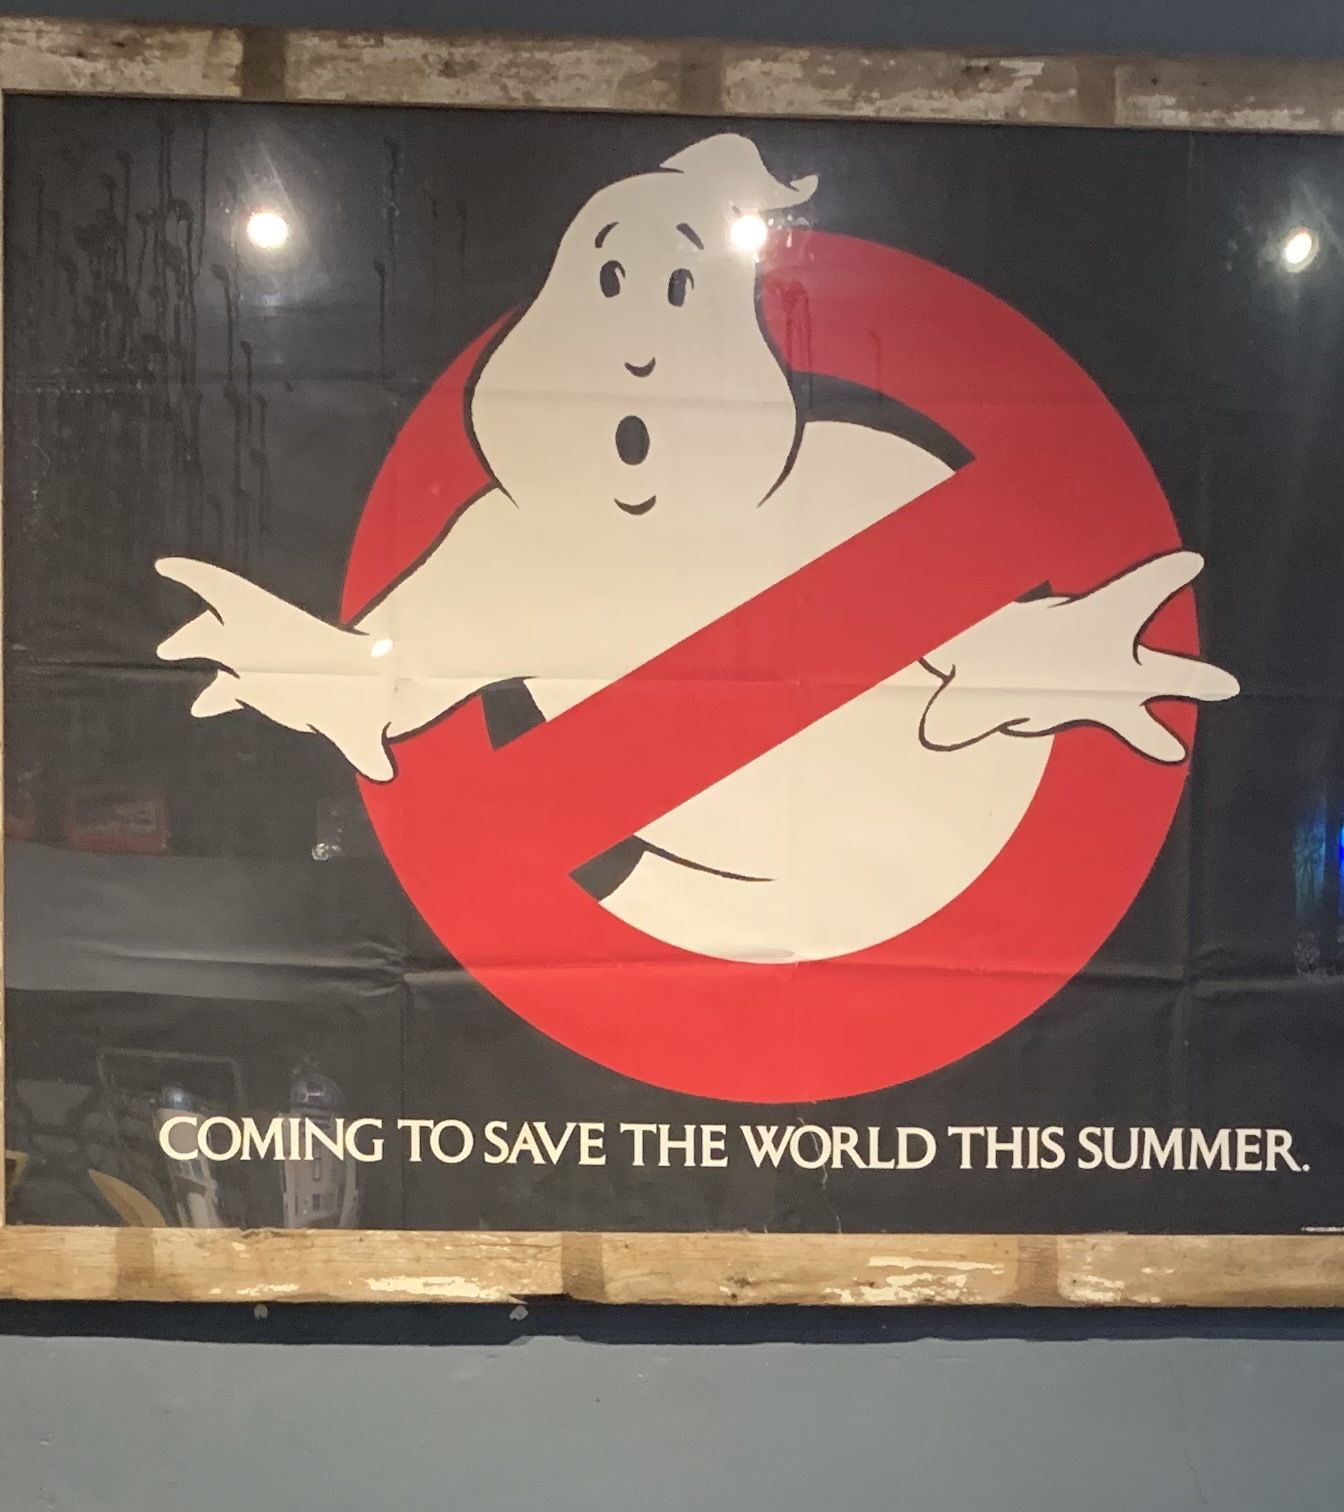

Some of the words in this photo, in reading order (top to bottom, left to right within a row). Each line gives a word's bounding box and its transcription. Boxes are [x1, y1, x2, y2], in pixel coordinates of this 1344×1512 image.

[158, 1115, 384, 1163] COMING
[397, 1118, 474, 1165] TO
[483, 1120, 607, 1167] SAVE
[619, 1122, 730, 1168] THE
[740, 1123, 936, 1170] WORLD
[947, 1125, 1065, 1171] THIS
[1077, 1125, 1311, 1173] SUMMER.
